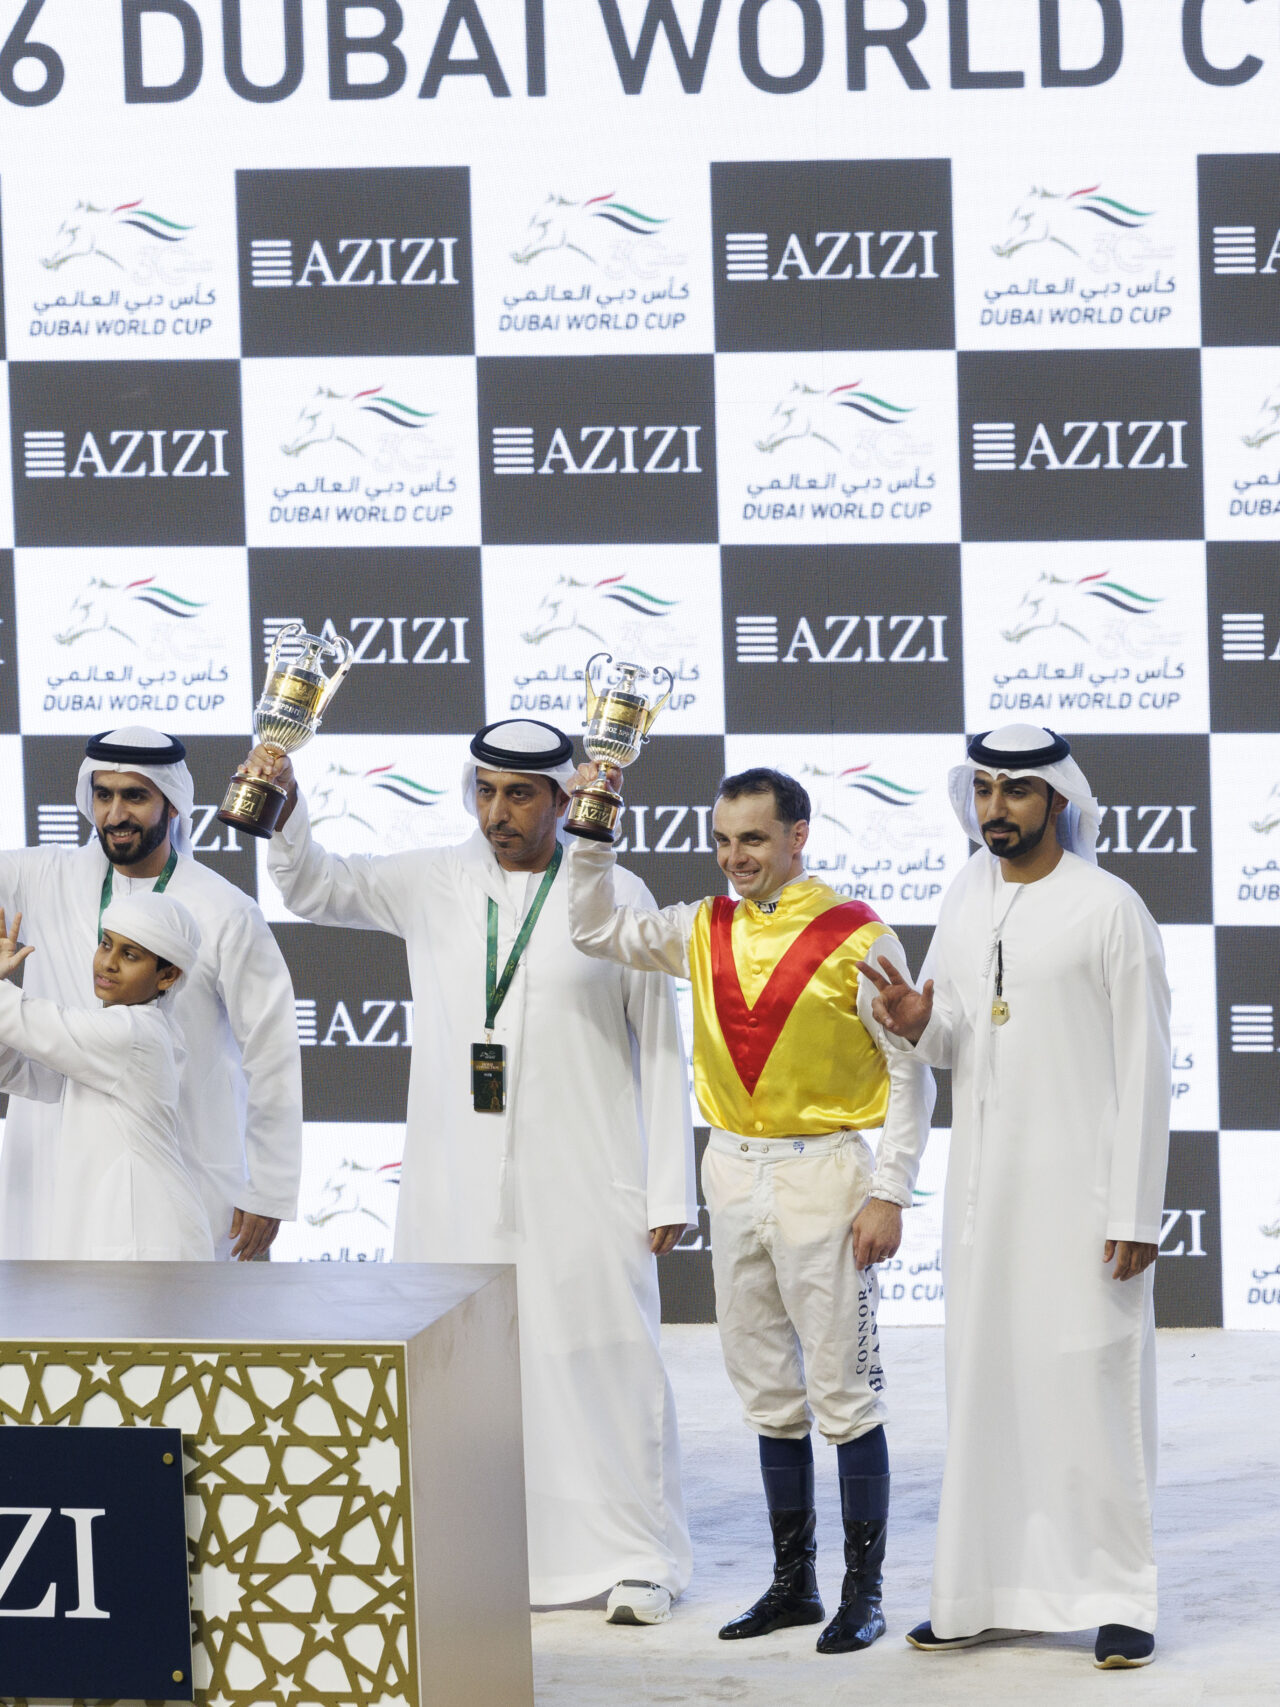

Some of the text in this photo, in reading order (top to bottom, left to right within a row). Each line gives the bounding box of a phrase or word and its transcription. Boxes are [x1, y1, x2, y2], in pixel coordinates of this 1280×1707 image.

[124, 0, 547, 105] DUBAI
[603, 0, 1121, 97] WORLD
[296, 238, 459, 287] AZIZI
[772, 231, 939, 280] AZIZI
[33, 284, 216, 316] كأس دبي العالمي
[502, 278, 690, 310] كأس دبي العالمي
[984, 271, 1176, 304] كأس دبي العالمي
[29, 318, 212, 337] DUBAI WORLD CUP
[499, 312, 686, 332] DUBAI WORLD CUP
[980, 306, 1172, 326] DUBAI WORLD CUP
[69, 430, 229, 477] AZIZI
[538, 426, 702, 474] AZIZI
[1019, 421, 1188, 469] AZIZI
[272, 471, 457, 502] كأس دبي العالمي
[746, 466, 936, 498] كأس دبي العالمي
[269, 505, 453, 523] DUBAI WORLD CUP
[742, 501, 932, 520] DUBAI WORLD CUP
[782, 615, 948, 662] AZIZI
[46, 660, 229, 690] كأس دبي العالمي
[993, 657, 1184, 688] كأس دبي العالمي
[43, 694, 225, 712] DUBAI WORLD CUP
[510, 693, 572, 711] DUBAI
[989, 691, 1180, 710] DUBAI WORLD CUP
[851, 859, 893, 879] دبي
[897, 849, 946, 875] كأس
[900, 883, 942, 901] CUP
[1238, 884, 1280, 901] DUB
[321, 1001, 413, 1047] AZI
[856, 1289, 869, 1376] CONNOR
